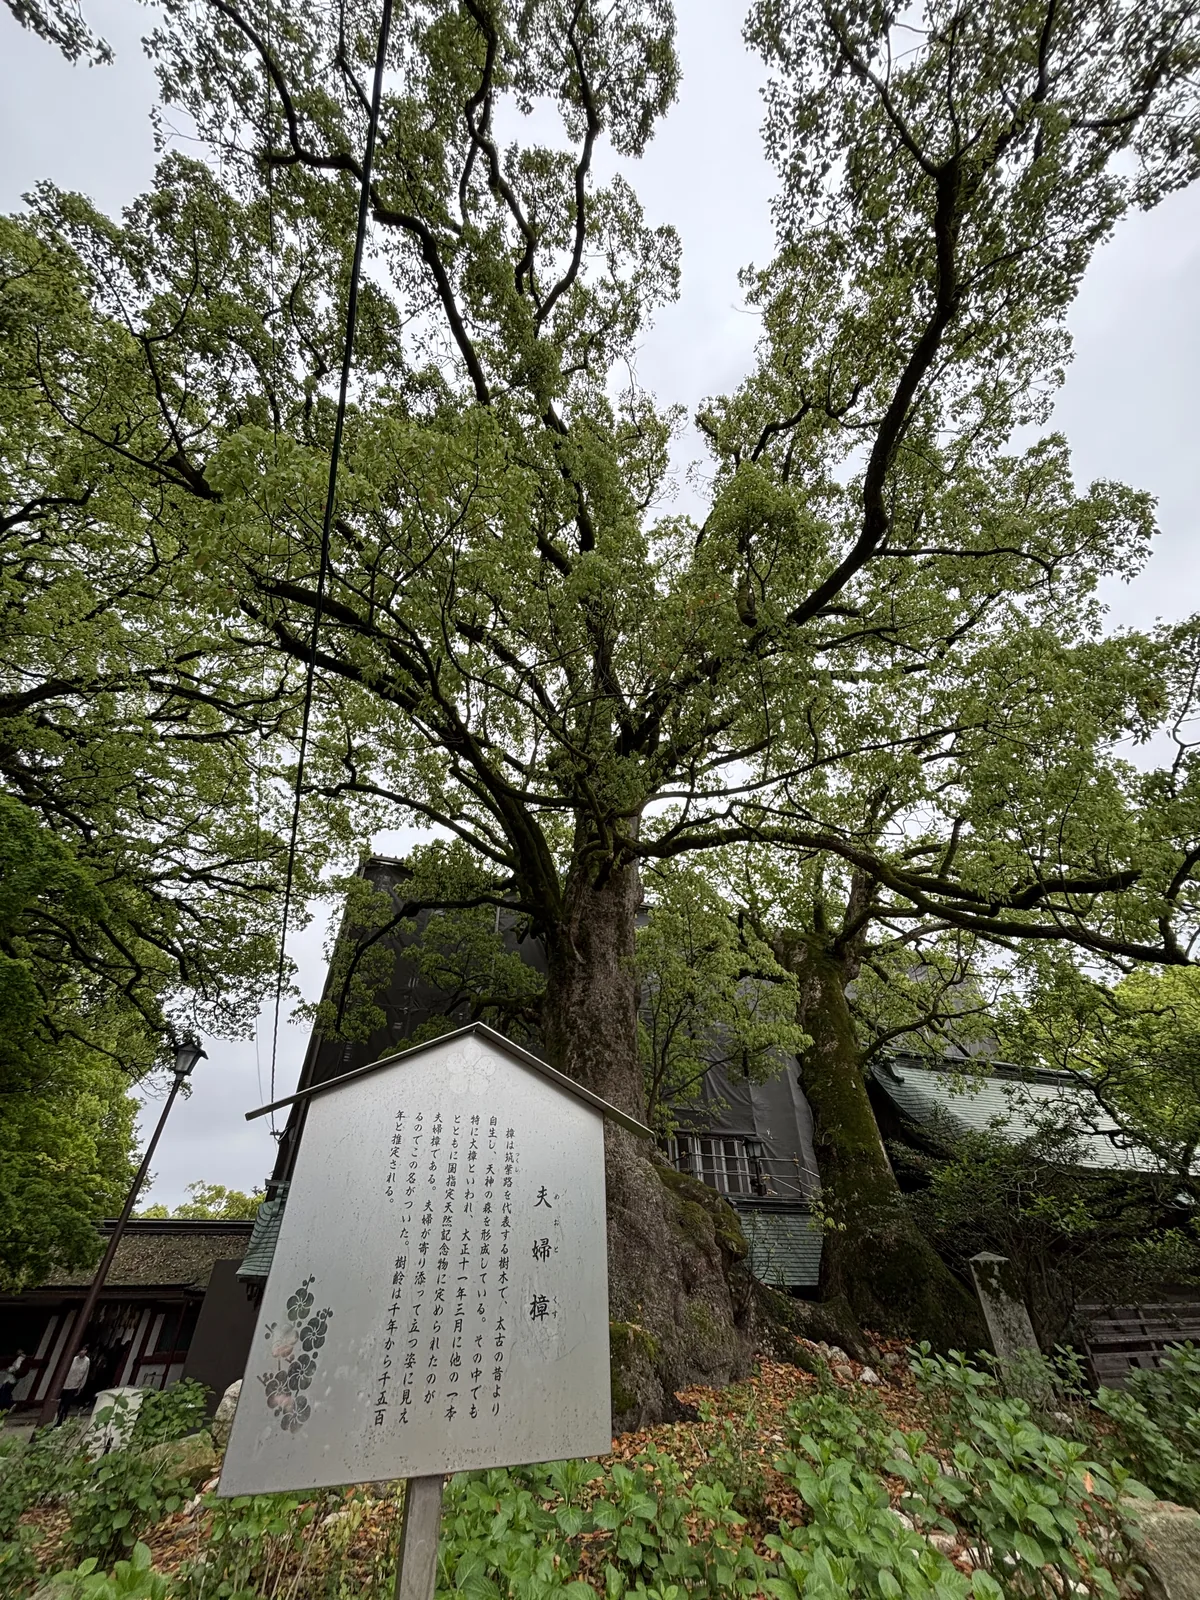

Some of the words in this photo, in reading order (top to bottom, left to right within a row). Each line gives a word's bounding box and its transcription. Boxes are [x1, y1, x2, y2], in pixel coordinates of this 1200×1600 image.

[384, 1109, 406, 1203] 年と推定される。
[423, 1114, 461, 1404] とともに国指定天然記念物に定められたのが
[530, 1185, 552, 1321] 夫婦樟
